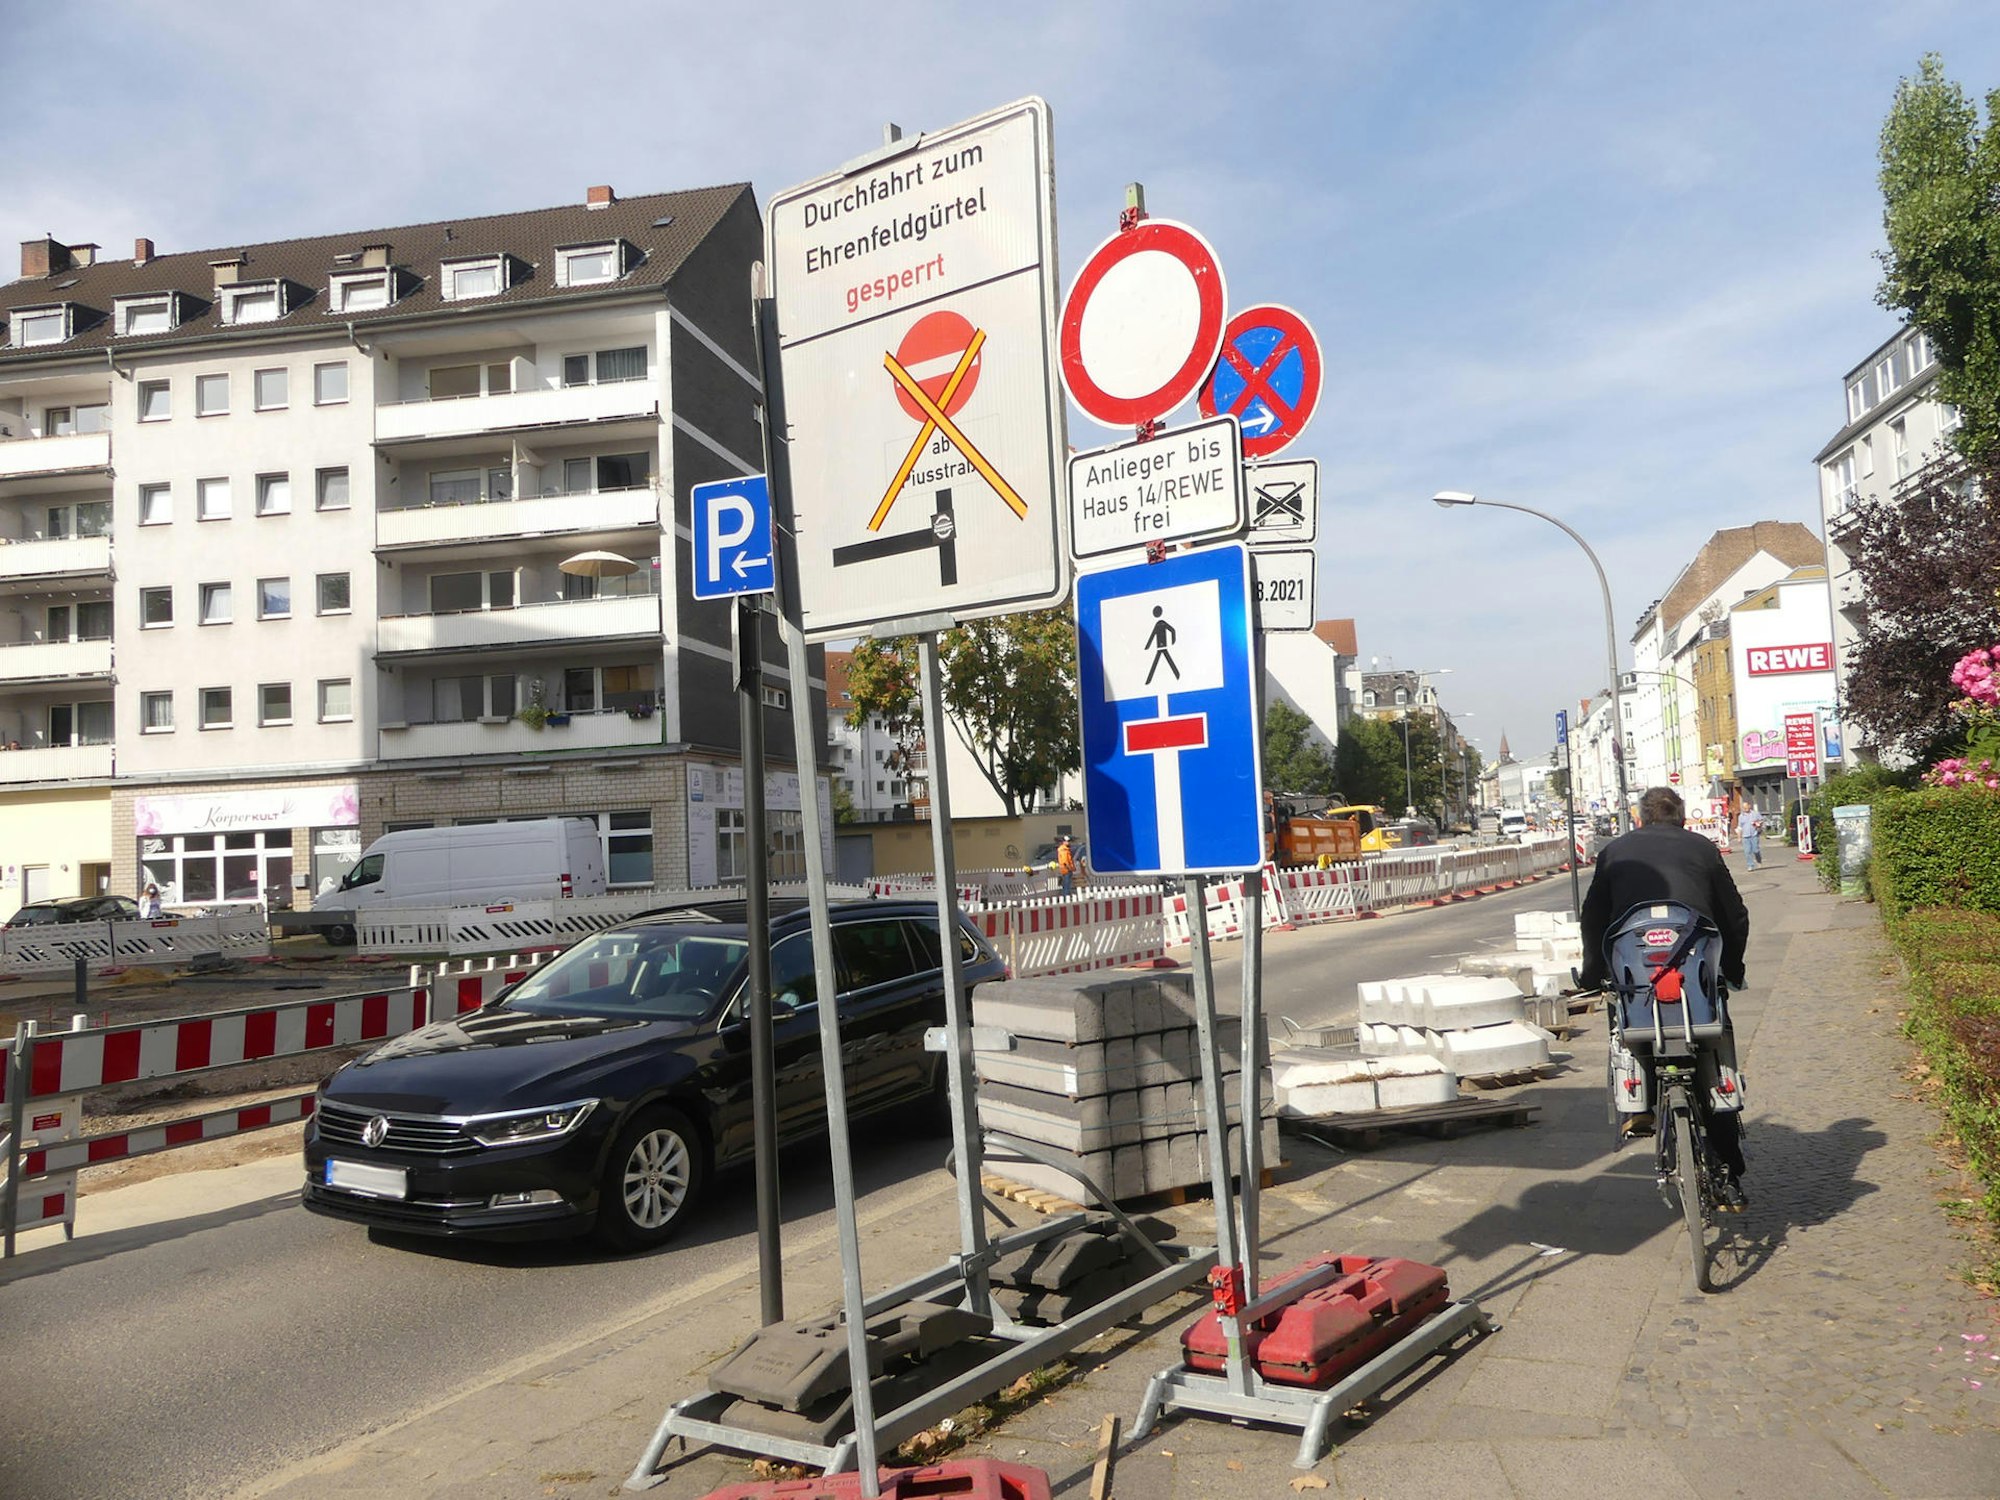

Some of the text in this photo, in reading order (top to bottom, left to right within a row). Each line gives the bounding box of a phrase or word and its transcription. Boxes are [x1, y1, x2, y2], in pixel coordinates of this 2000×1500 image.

[804, 145, 983, 228] Durchfahrt zum
[806, 187, 986, 273] Ehrenfeldgürtel
[847, 254, 944, 312] gesperrt
[932, 436, 950, 454] ab
[1086, 438, 1221, 487] Anlieger bis
[1083, 468, 1224, 519] Haus 14/REWE
[708, 495, 754, 582] P
[1134, 505, 1170, 533] frei
[1750, 646, 1826, 671] REWE
[1786, 717, 1812, 725] REWE
